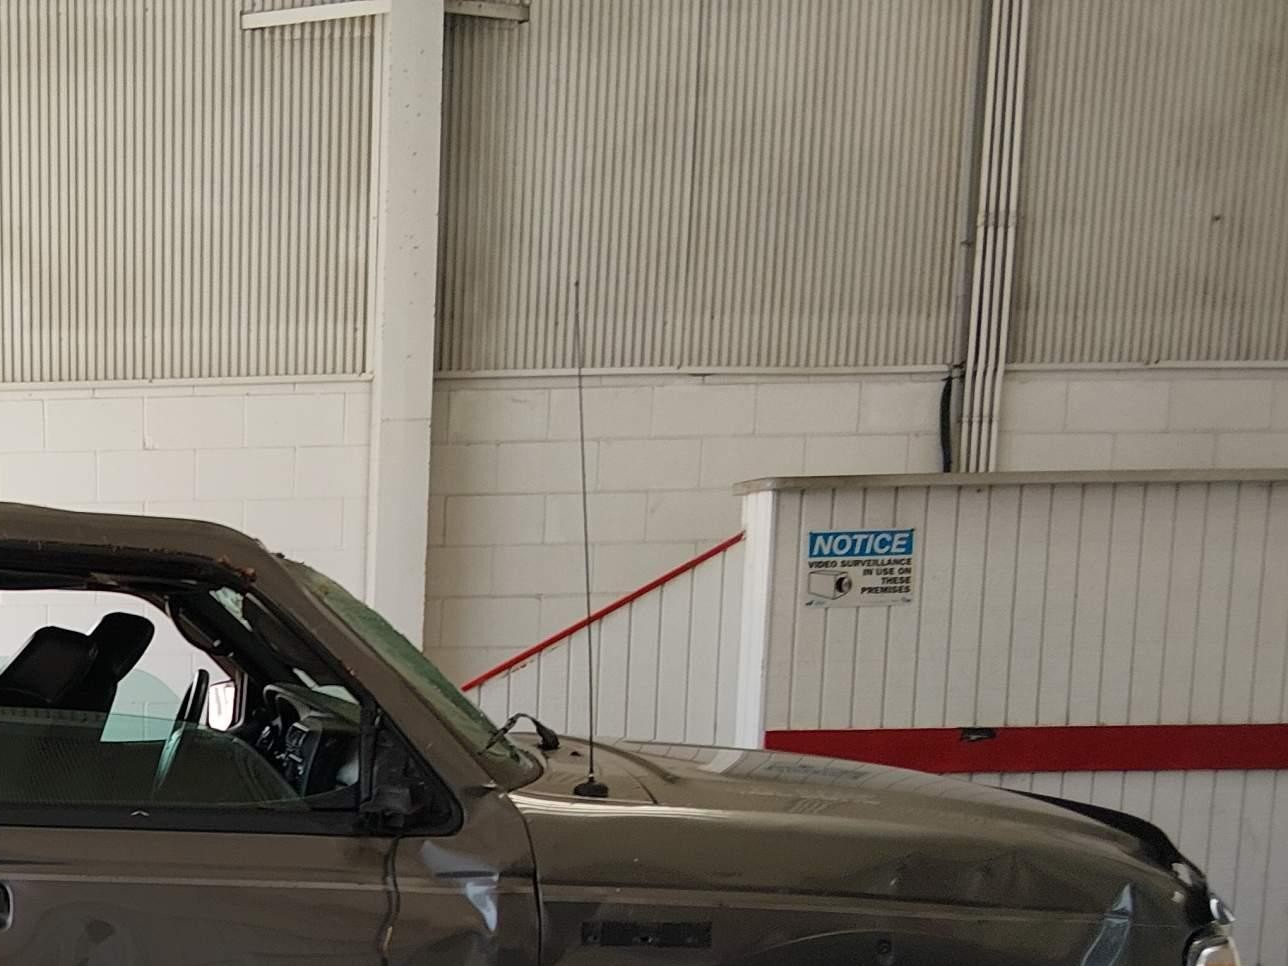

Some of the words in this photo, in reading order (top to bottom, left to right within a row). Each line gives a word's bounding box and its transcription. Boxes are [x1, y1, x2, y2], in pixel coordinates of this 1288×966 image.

[812, 532, 910, 555] NOTICE
[808, 559, 838, 568] VIDEO
[840, 557, 912, 567] SURVEILLANCE
[862, 568, 874, 576] IN
[876, 567, 895, 576] USE
[898, 567, 912, 575] ON
[881, 576, 912, 584] THESE
[860, 585, 911, 594] PREMISES
